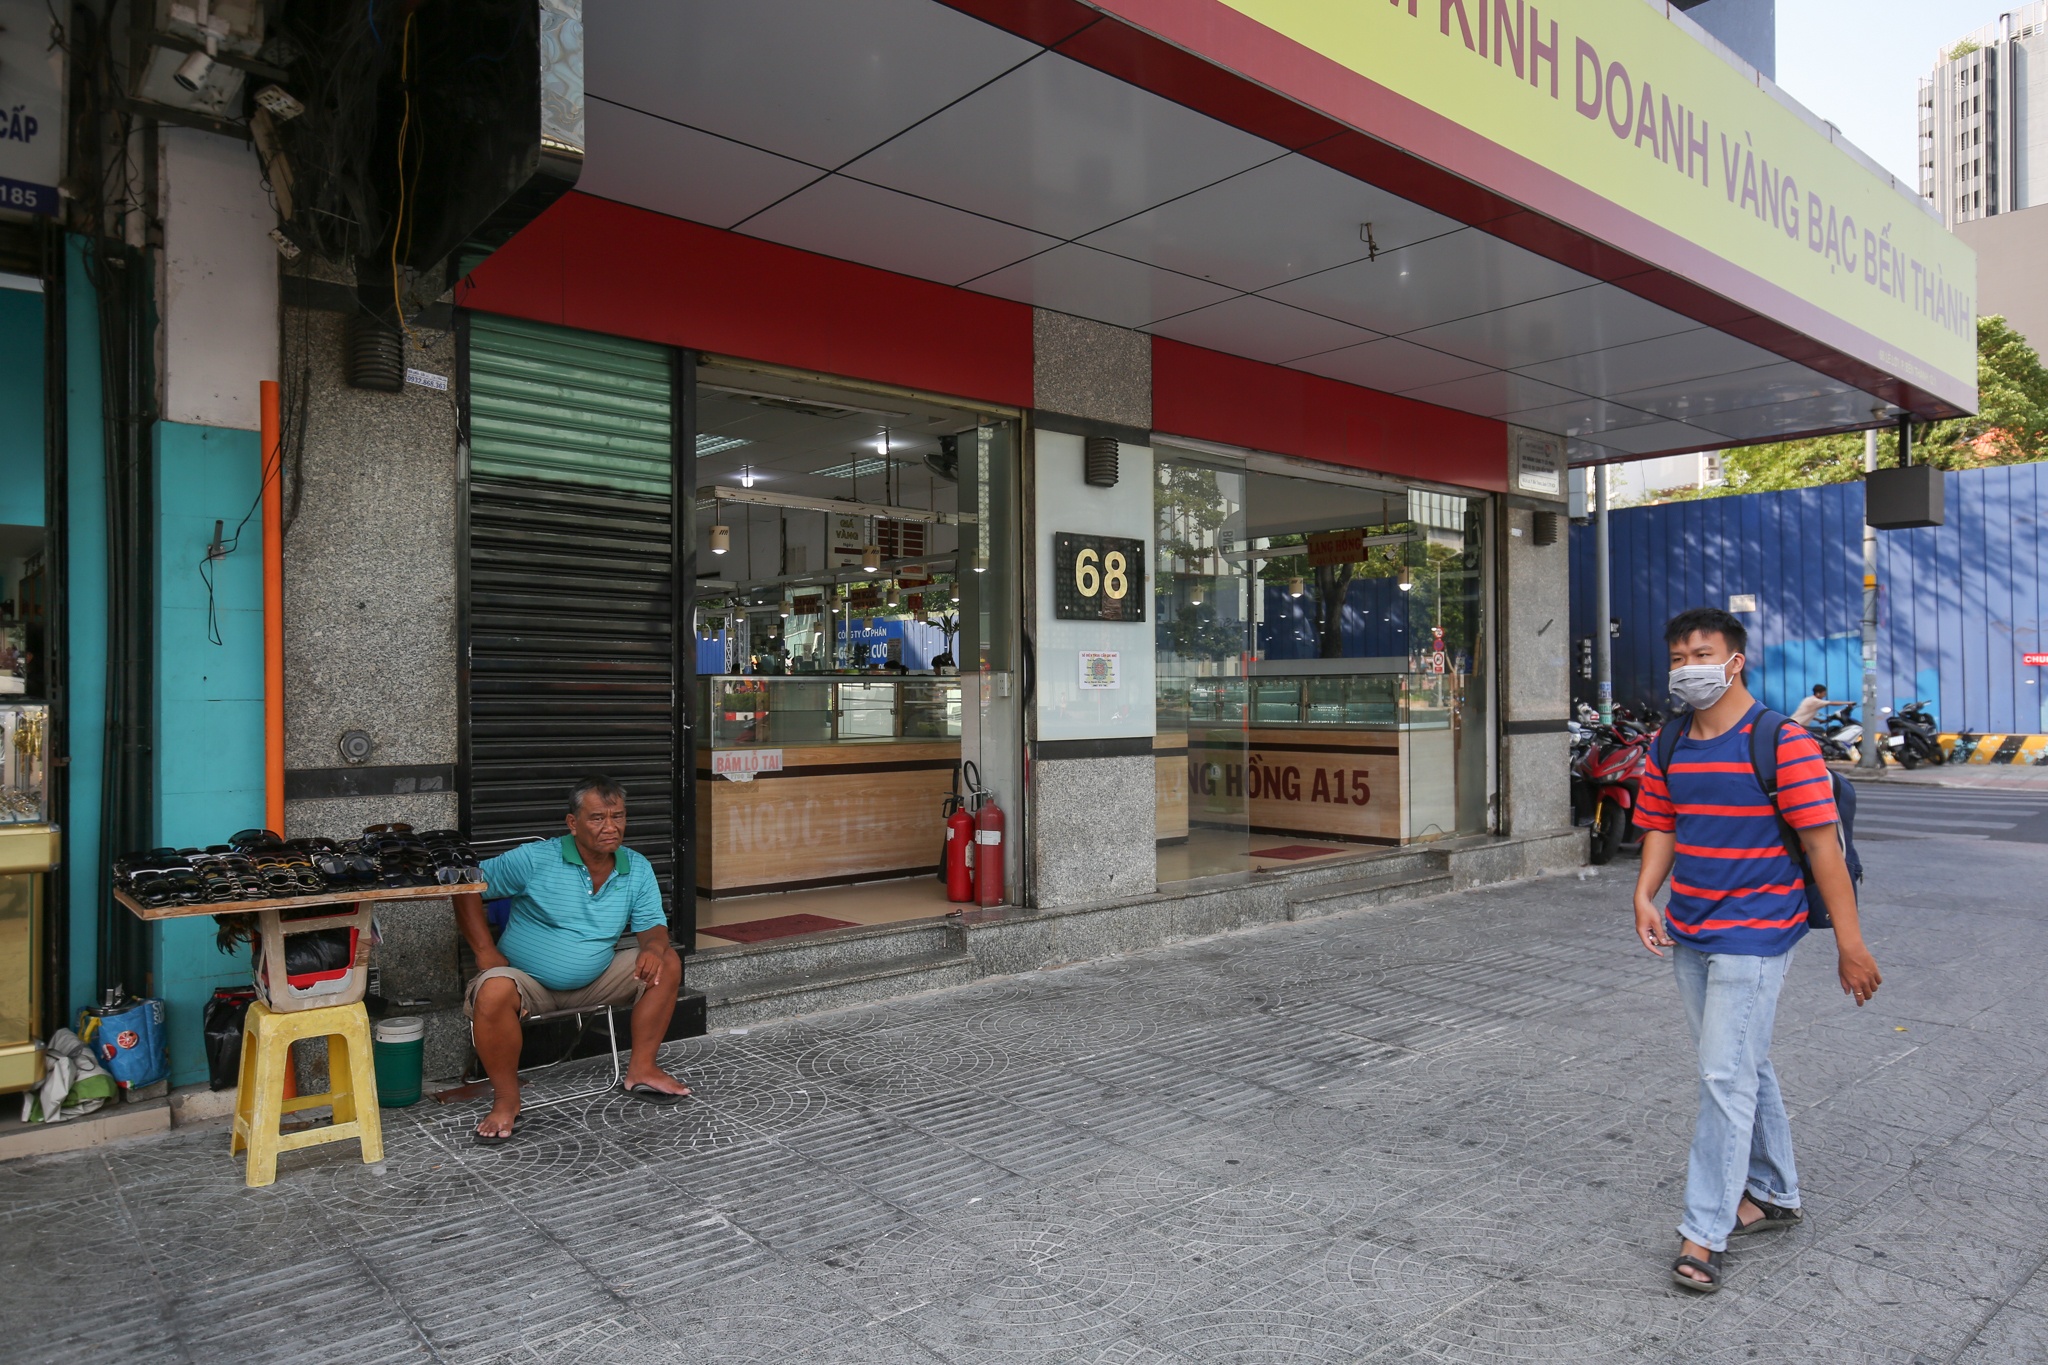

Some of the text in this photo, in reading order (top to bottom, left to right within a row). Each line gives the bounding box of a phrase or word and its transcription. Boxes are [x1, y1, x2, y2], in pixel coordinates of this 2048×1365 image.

[1575, 35, 1709, 189] DOANH
[1720, 130, 1800, 241] VÀNG
[1807, 190, 1858, 275] BẠC
[1863, 222, 1906, 303] BẾN
[1910, 262, 1971, 343] THÀNH
[1075, 548, 1129, 600] 68
[2025, 655, 2048, 664] CHU
[716, 750, 779, 773] BẤM LỖ TAI
[1226, 753, 1301, 802] HỒNG
[1311, 767, 1371, 806] A15
